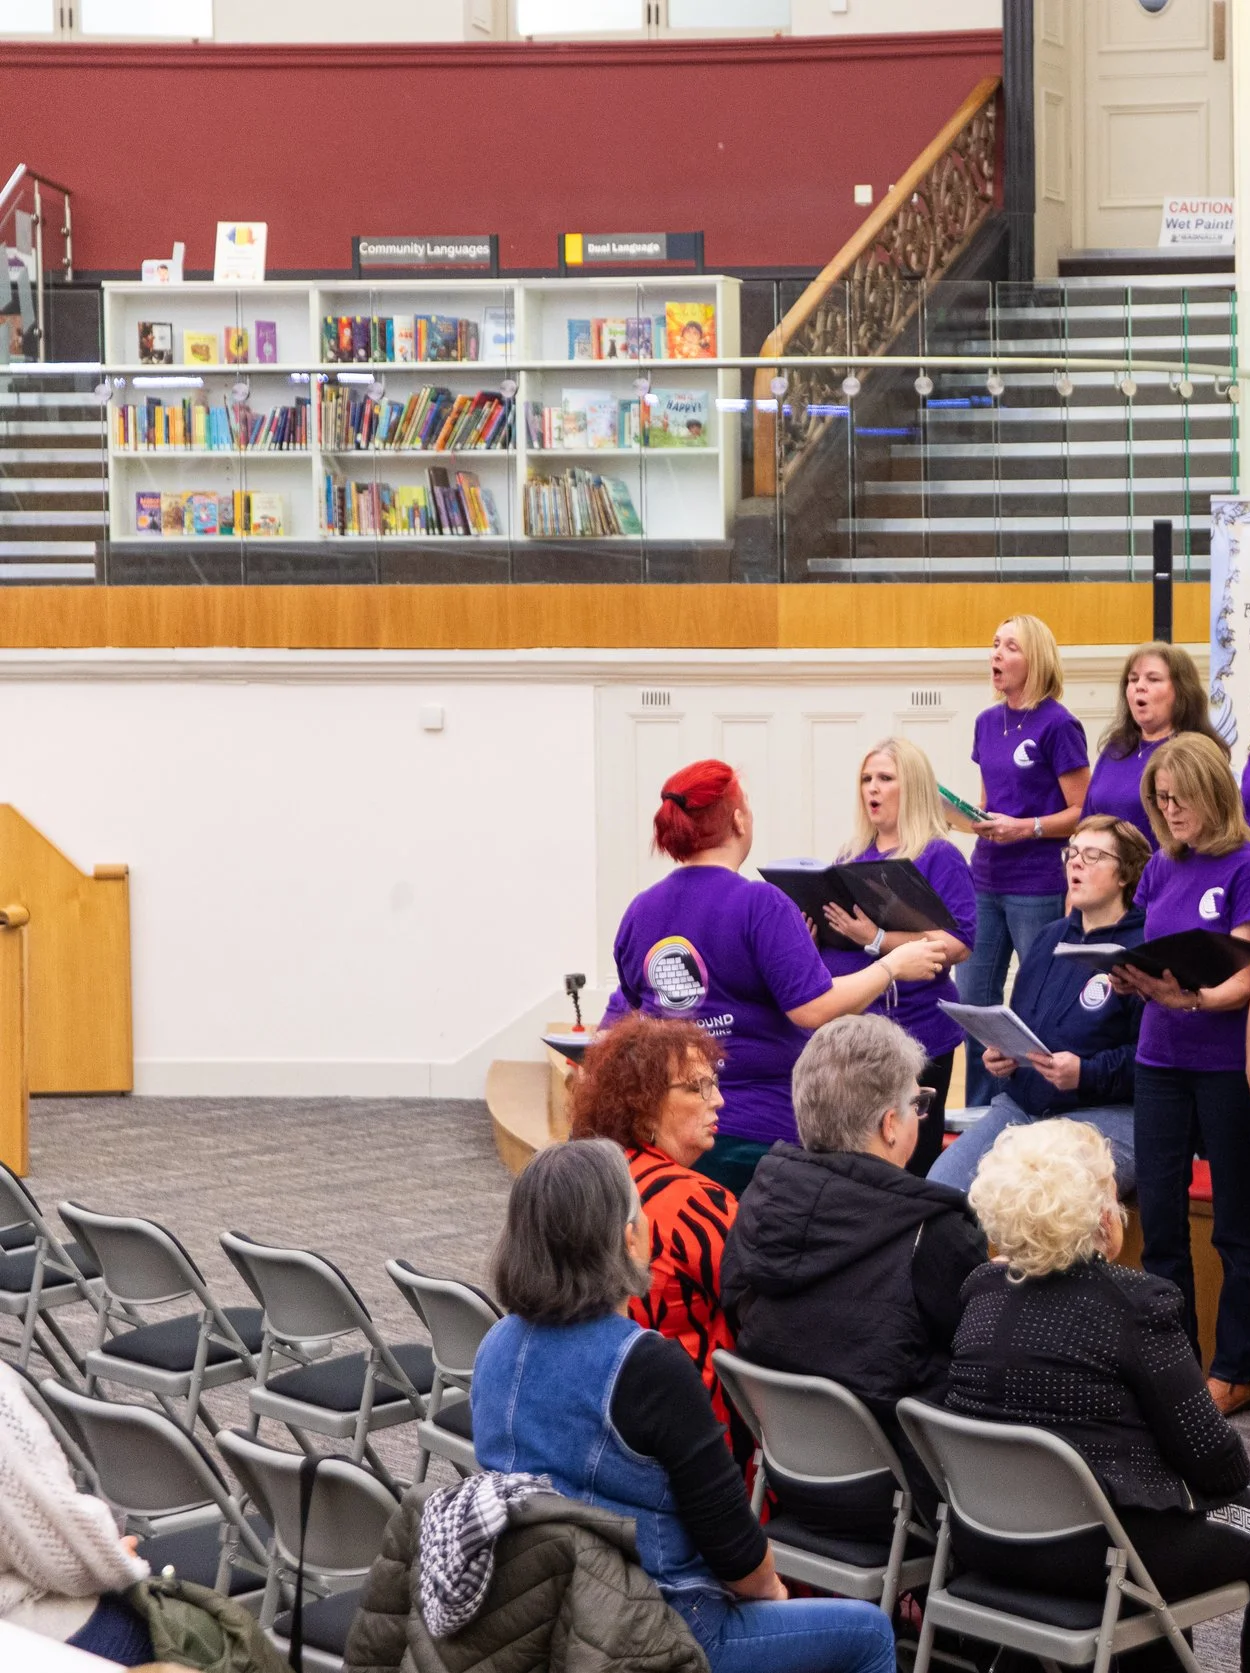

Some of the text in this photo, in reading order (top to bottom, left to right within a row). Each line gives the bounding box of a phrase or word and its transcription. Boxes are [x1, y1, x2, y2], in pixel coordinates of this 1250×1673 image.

[1169, 201, 1233, 214] CAUTION
[1165, 217, 1234, 230] Wet Paint!
[359, 241, 490, 258] Community Languages
[697, 1014, 734, 1028] OUND
